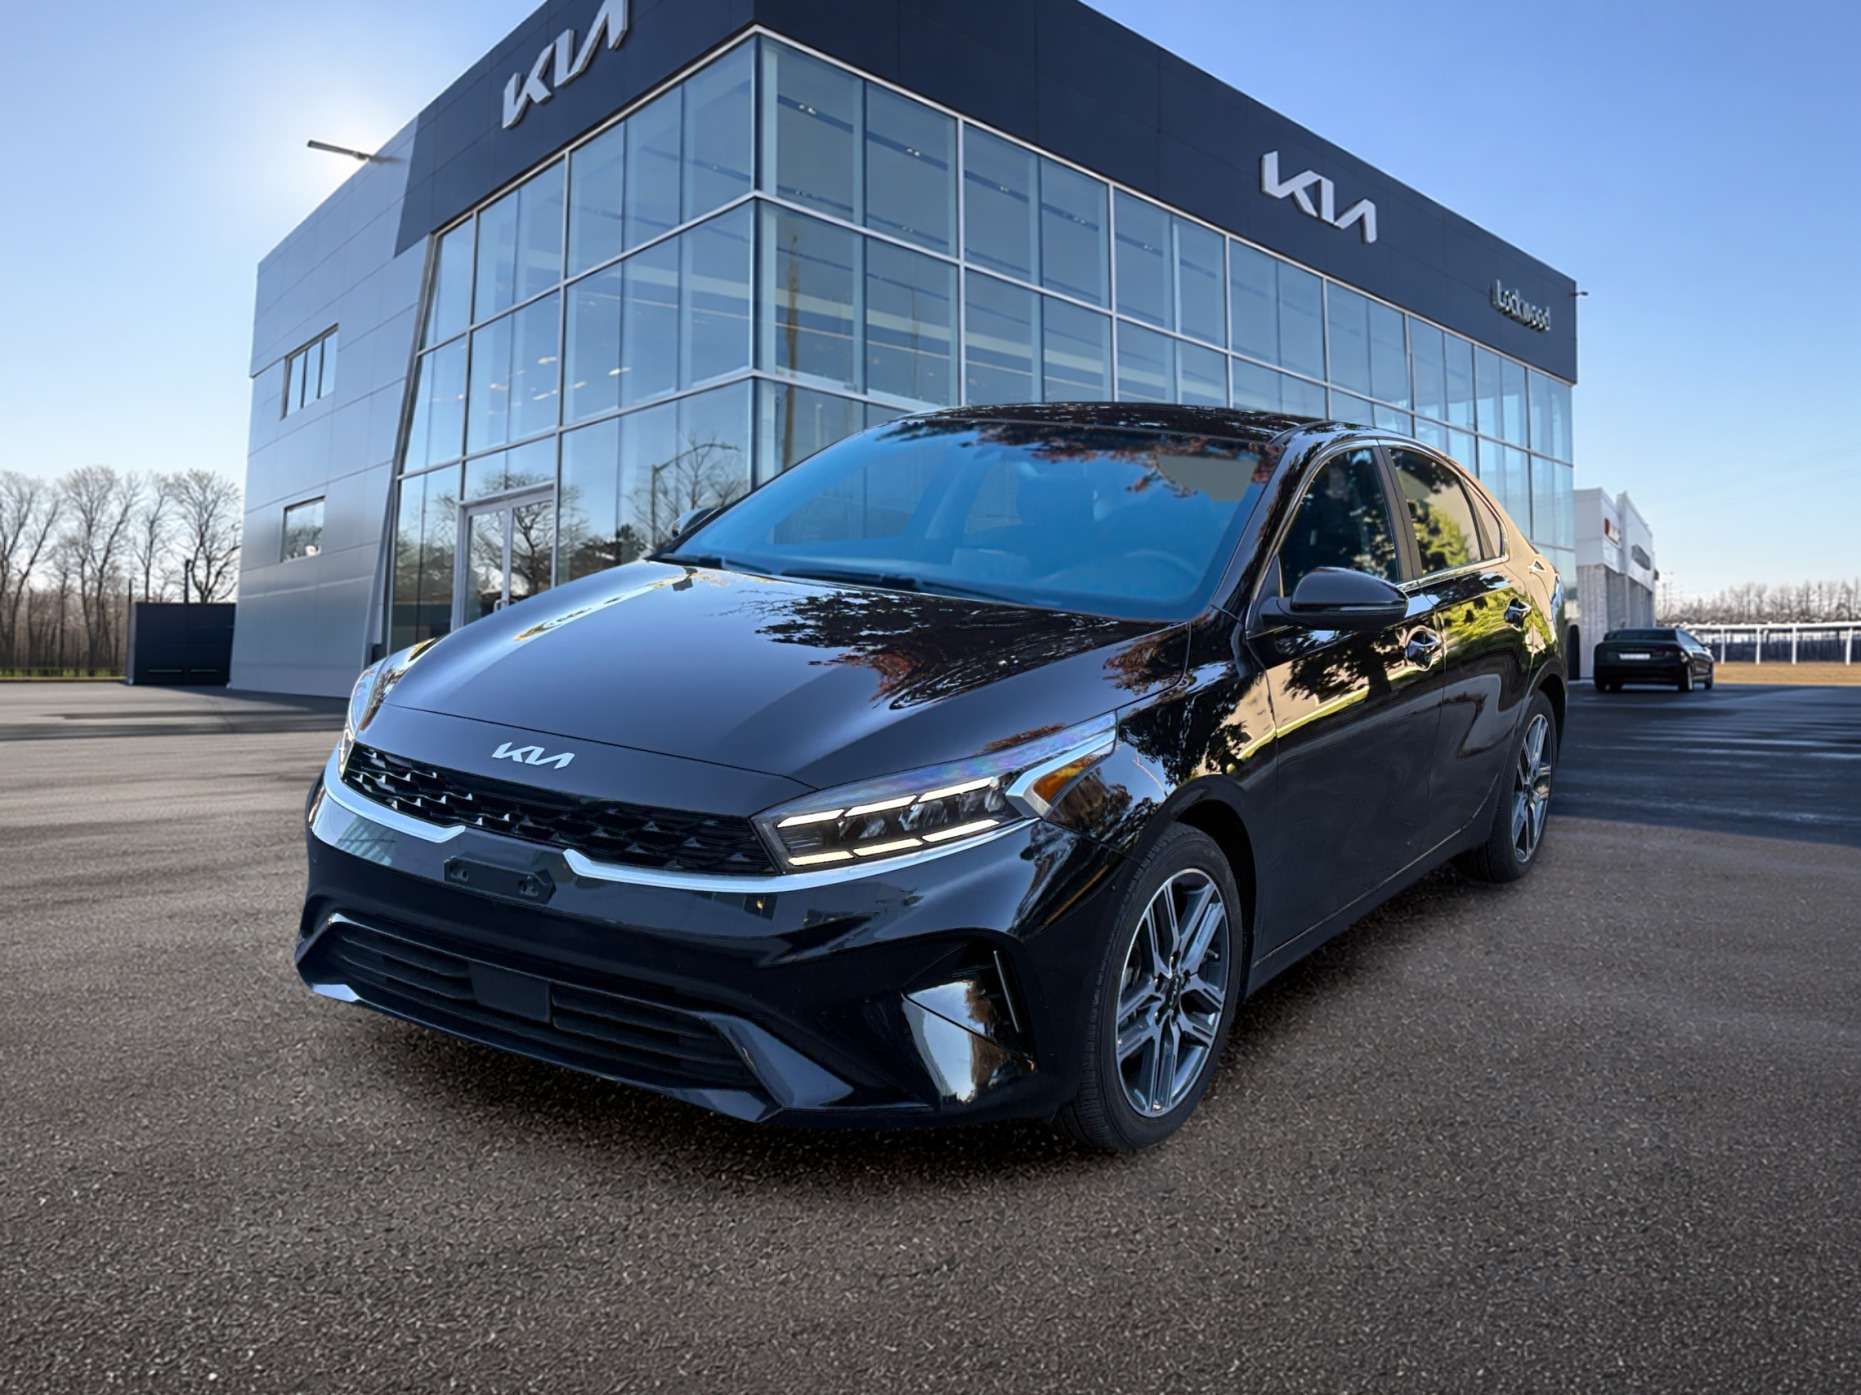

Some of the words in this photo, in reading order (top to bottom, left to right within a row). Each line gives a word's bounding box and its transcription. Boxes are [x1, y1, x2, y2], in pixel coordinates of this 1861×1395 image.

[502, 0, 627, 129] KIA
[1262, 150, 1377, 243] KIA
[492, 742, 575, 769] KIA
